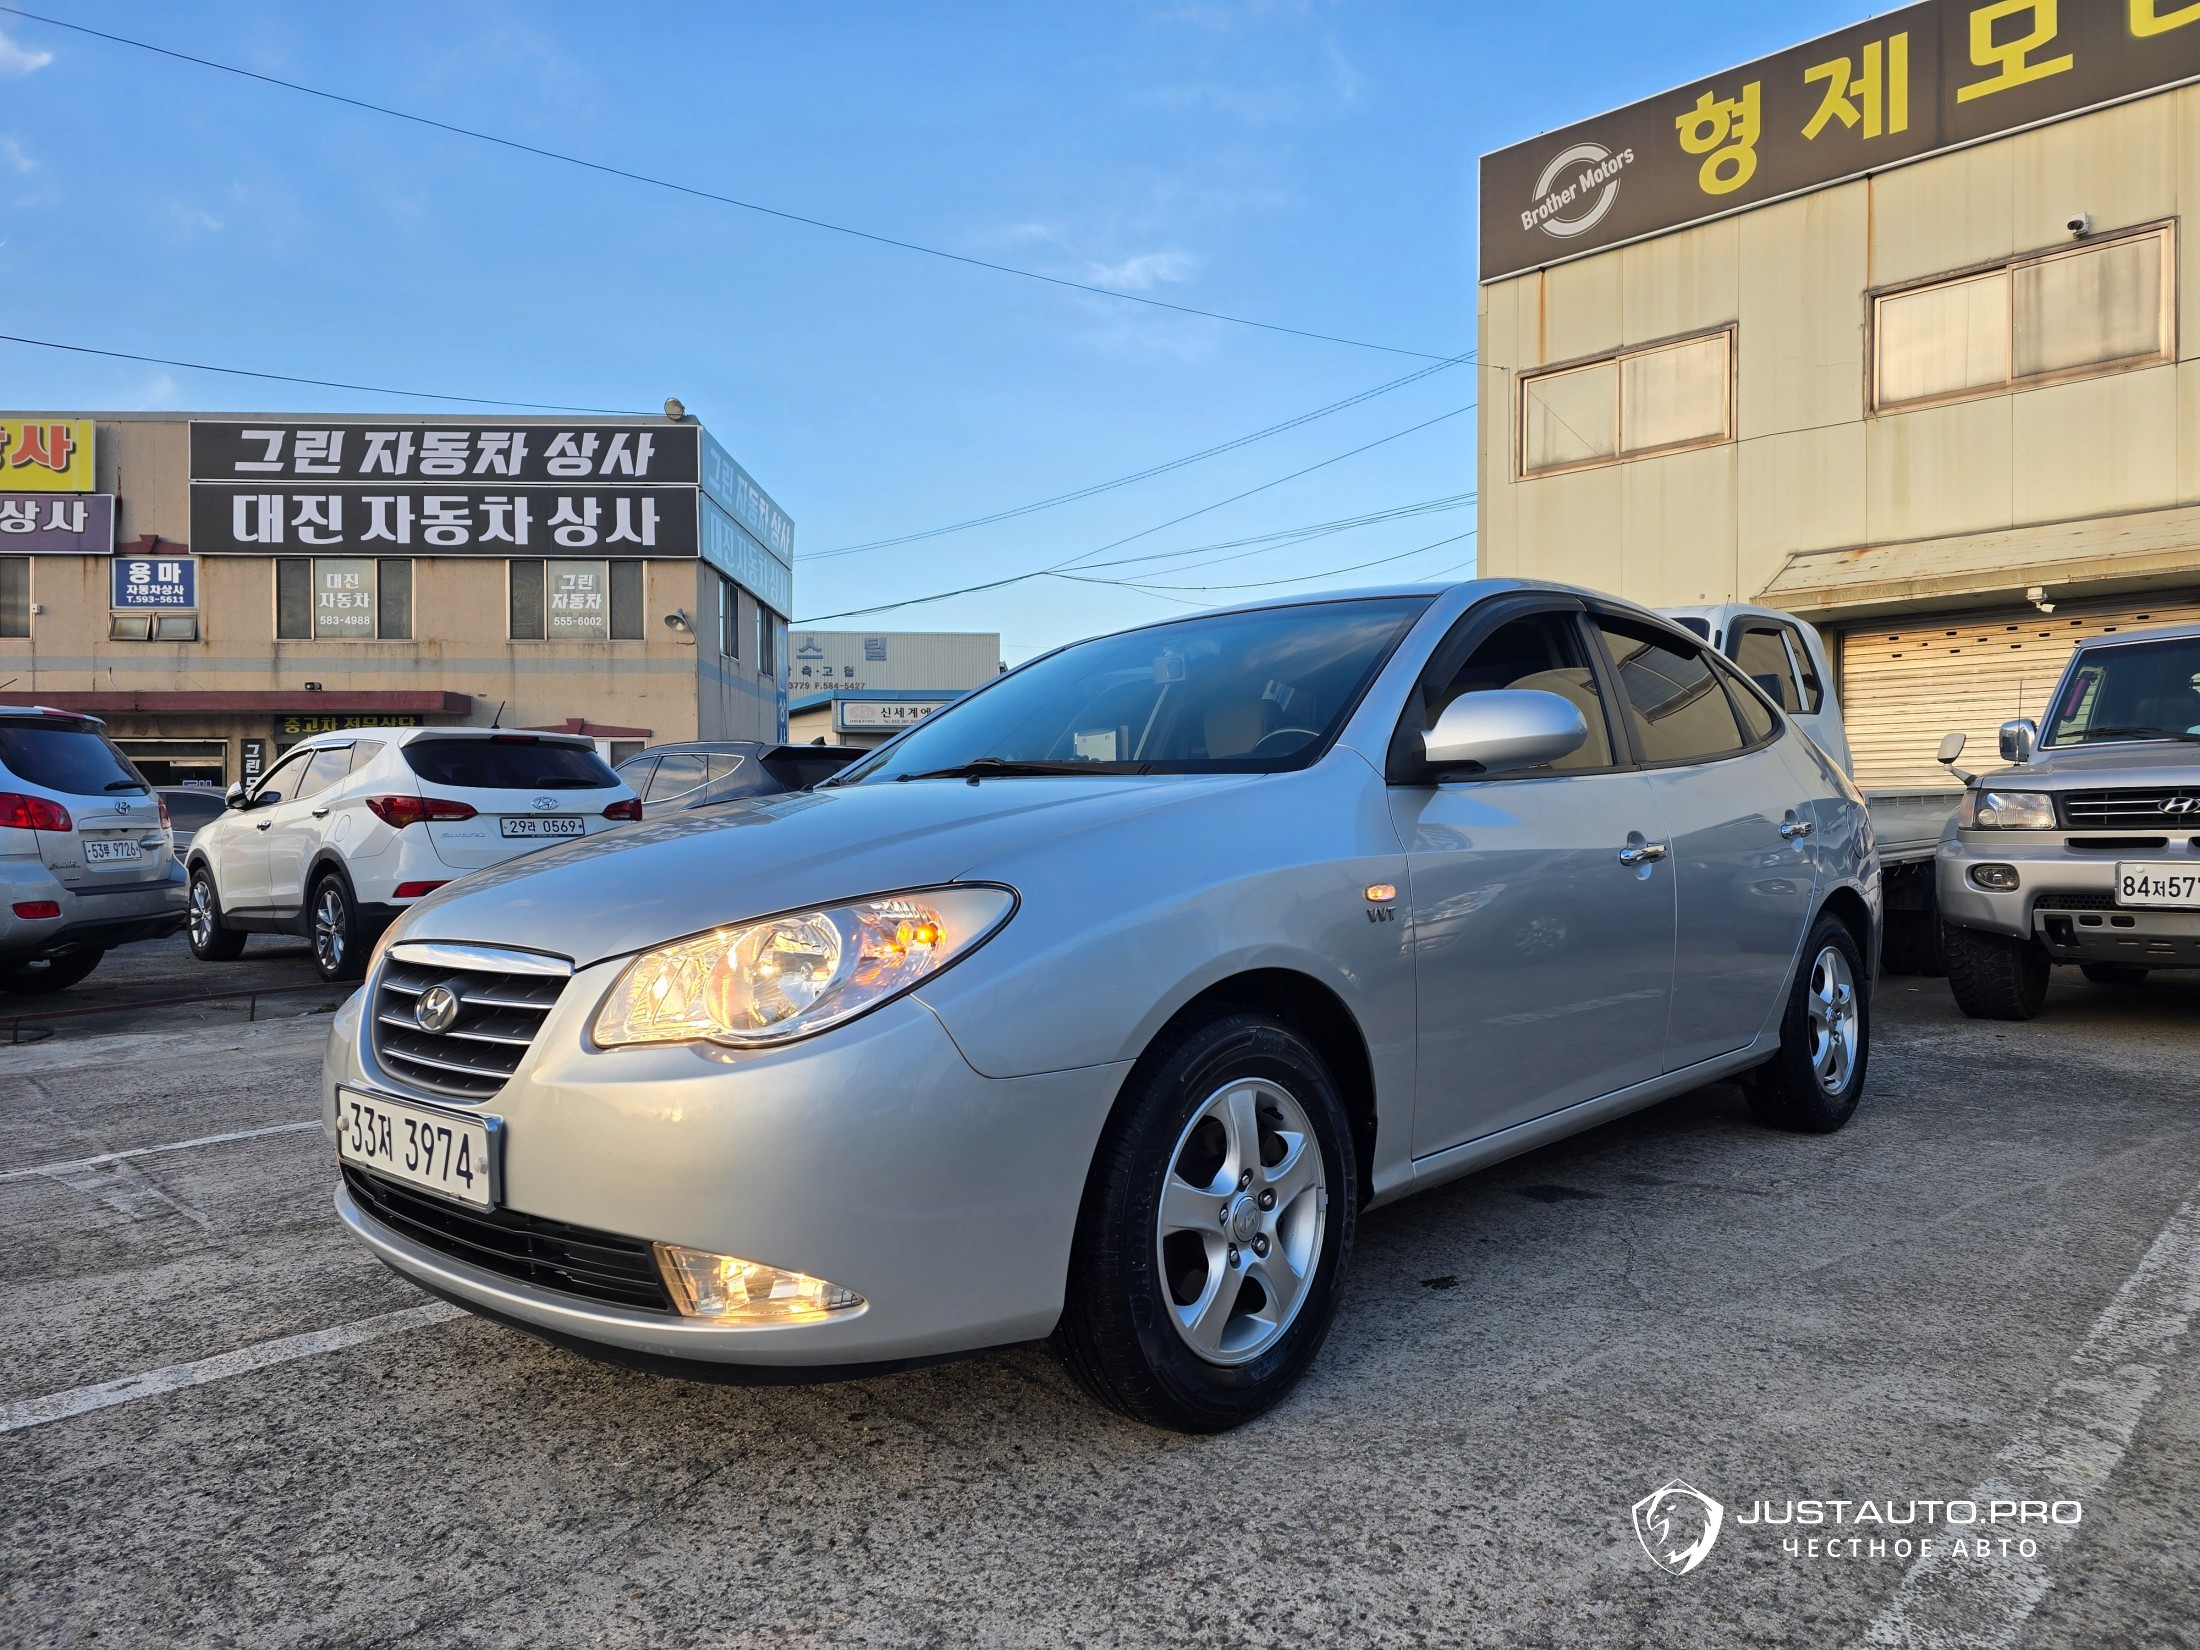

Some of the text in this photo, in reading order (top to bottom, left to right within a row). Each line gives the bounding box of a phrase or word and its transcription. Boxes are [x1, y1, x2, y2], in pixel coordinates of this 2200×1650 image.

[1520, 148, 1635, 231] Brother Motors
[0, 424, 73, 470] 사
[234, 430, 655, 477] 그린 자동차 상사
[708, 446, 734, 501] 그린
[233, 494, 660, 547] 대진 자동차 상사
[326, 573, 359, 589] 대진
[560, 574, 594, 590] 그린
[126, 585, 185, 595] 자동차상사
[126, 595, 185, 603] T.593-5611
[319, 592, 370, 608] 자동차
[551, 593, 602, 609] 자동차
[320, 616, 370, 625] 583-4988
[554, 616, 602, 626] 555-6002
[284, 716, 338, 734] 중고차
[509, 820, 576, 833] 29라 0569
[91, 842, 136, 859] 53루 9726
[2123, 875, 2200, 898] 84저57
[350, 1102, 474, 1190] 33저 3974
